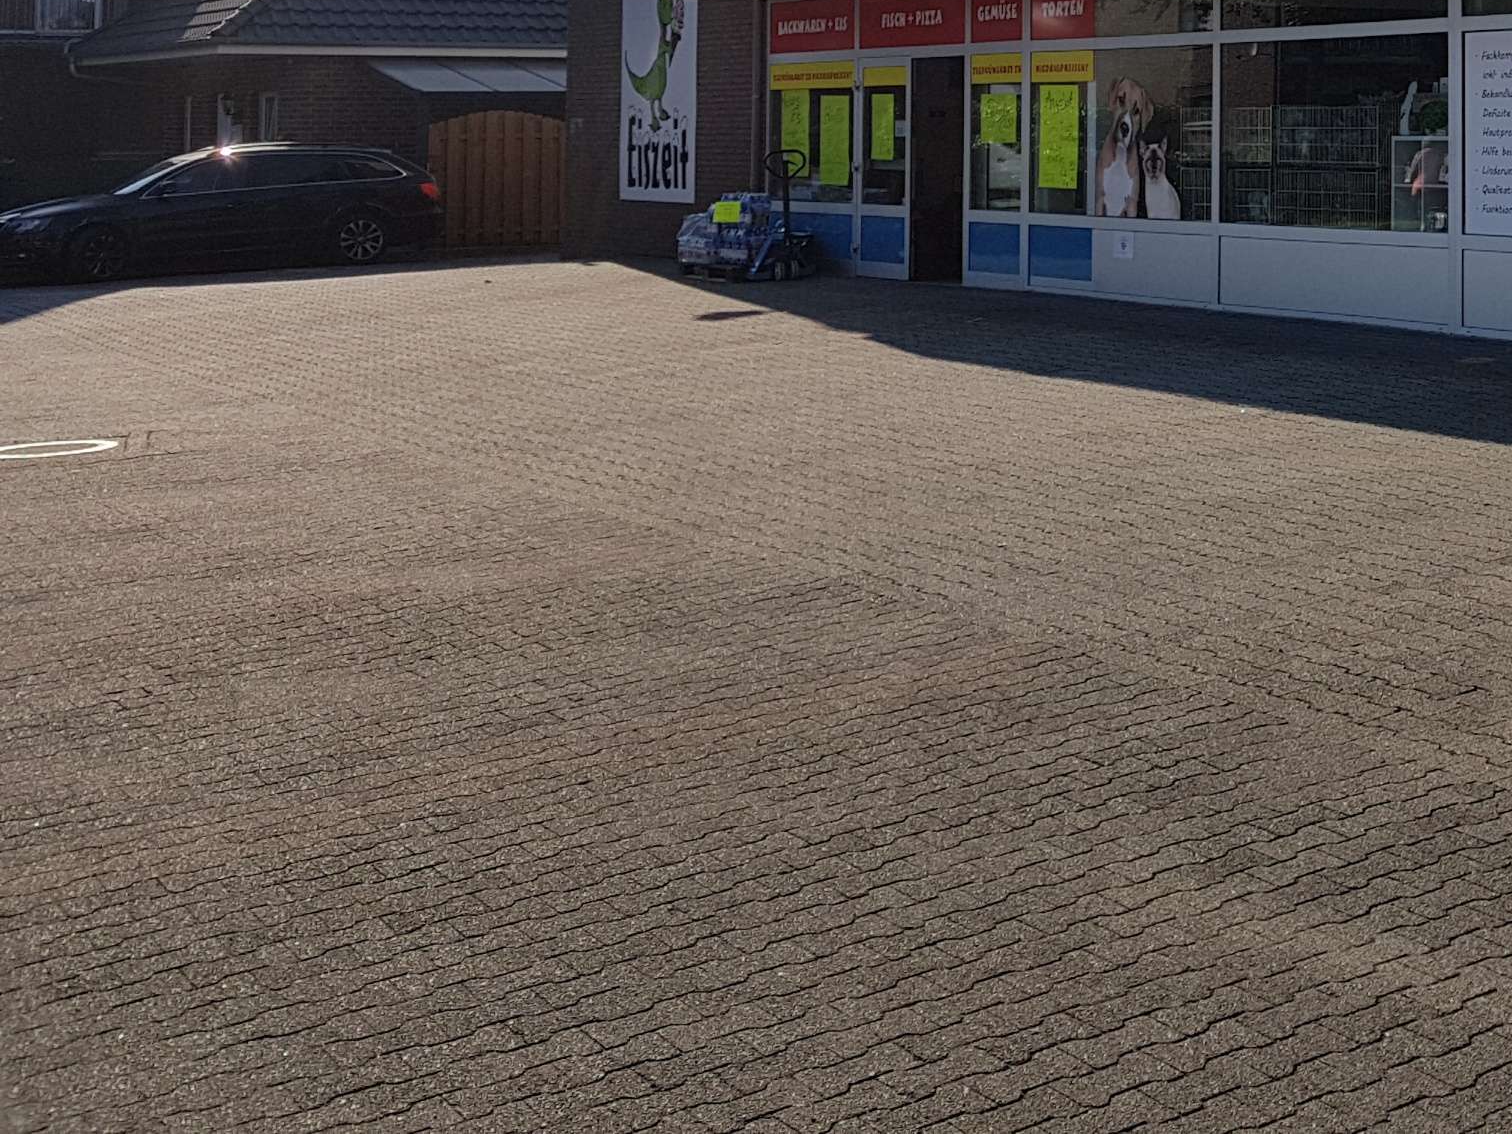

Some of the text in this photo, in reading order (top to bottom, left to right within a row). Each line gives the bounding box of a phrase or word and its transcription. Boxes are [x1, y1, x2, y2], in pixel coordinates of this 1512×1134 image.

[881, 12, 906, 28] FISCH
[916, 9, 943, 25] PIZZA
[977, 0, 1017, 22] GEMÜSE
[778, 17, 826, 35] BACKWAREN
[835, 16, 848, 31] EIS
[628, 106, 689, 190] Eiszeit
[1482, 147, 1498, 157] Hilfe
[1502, 148, 1512, 157] bei
